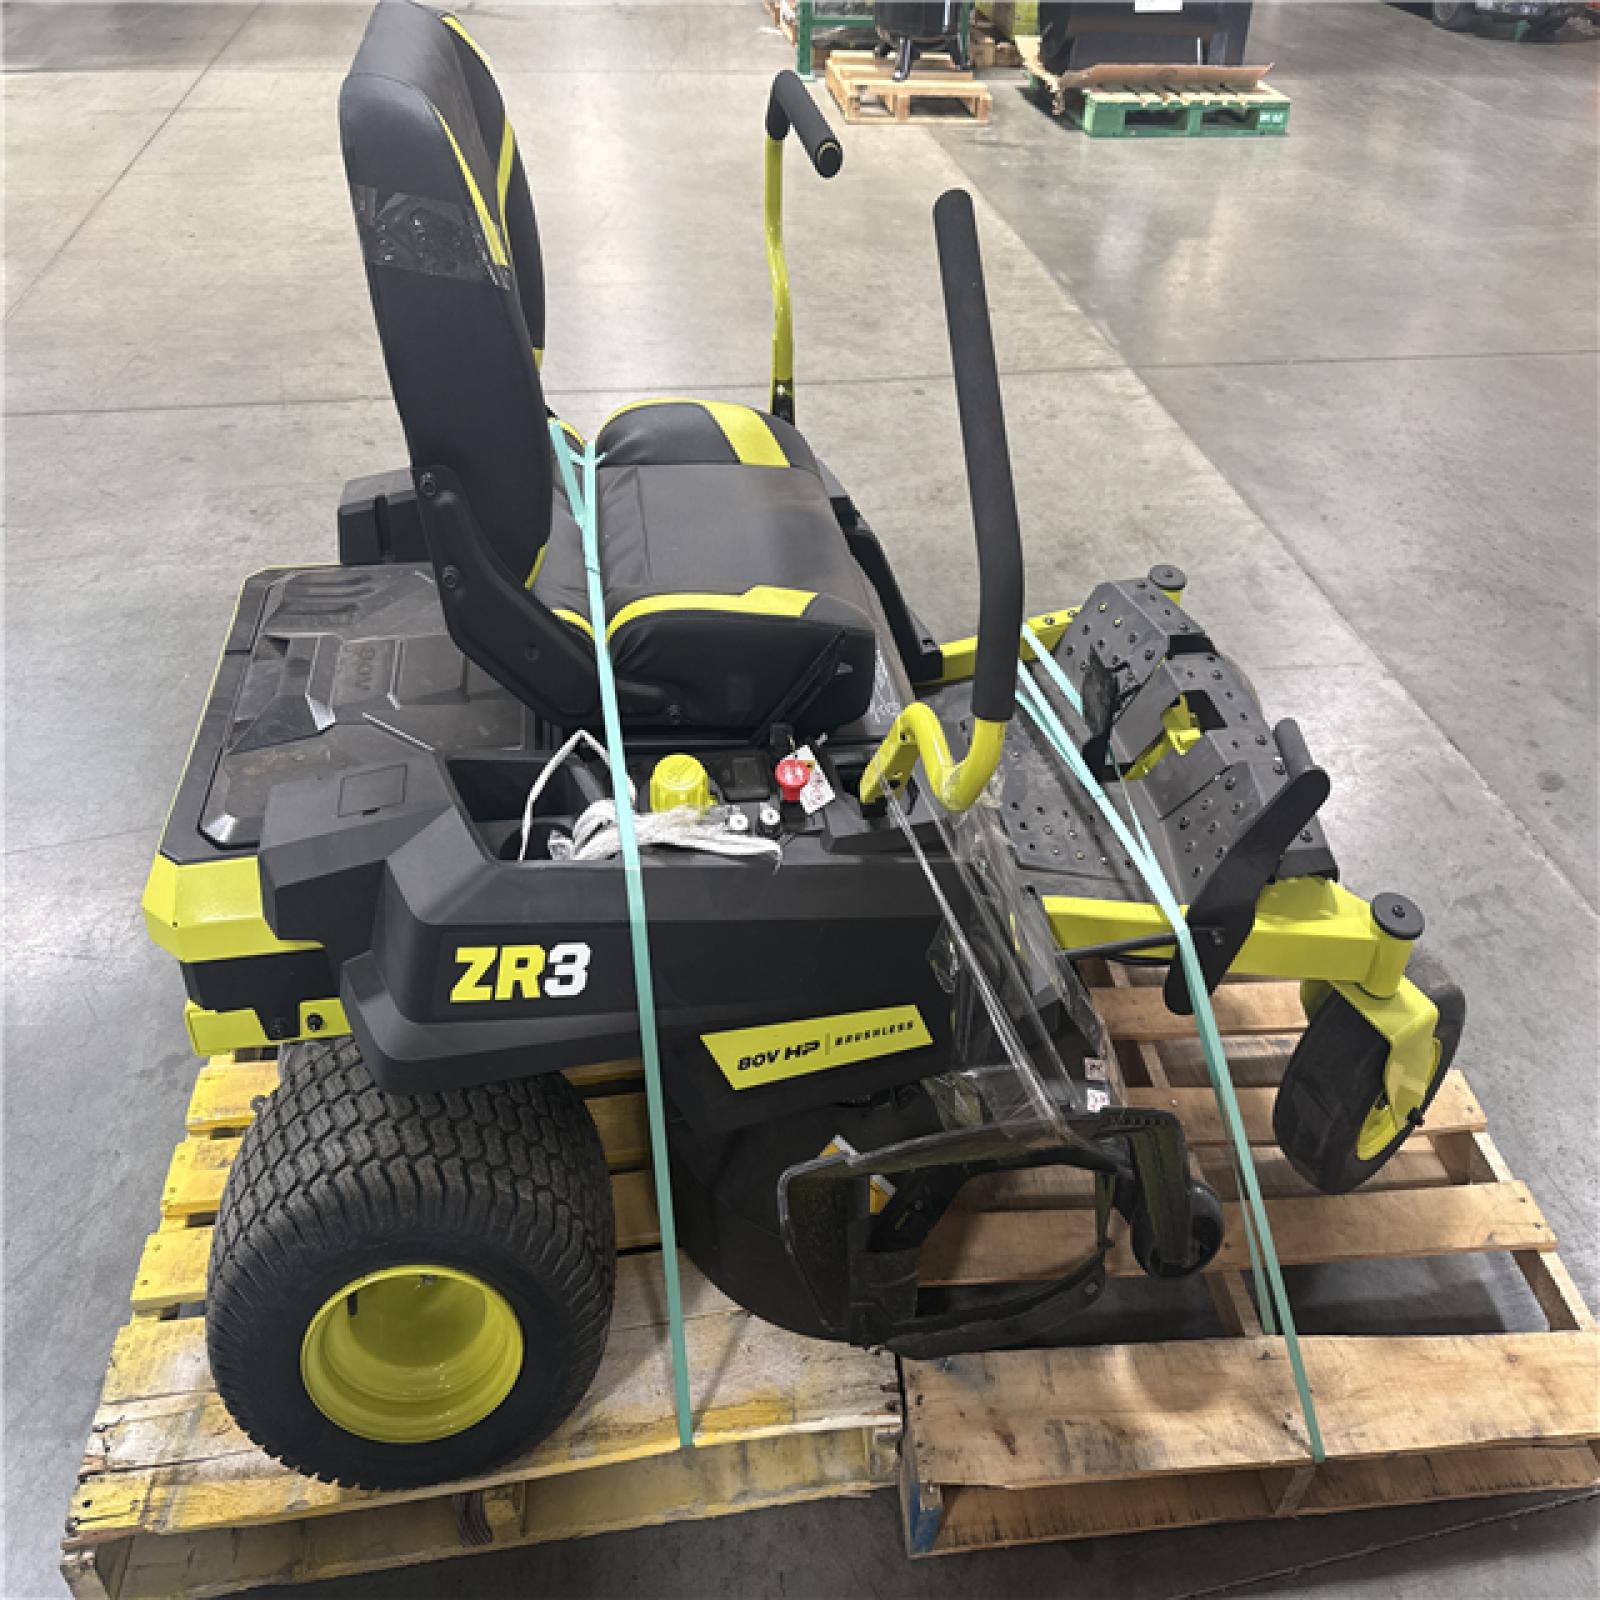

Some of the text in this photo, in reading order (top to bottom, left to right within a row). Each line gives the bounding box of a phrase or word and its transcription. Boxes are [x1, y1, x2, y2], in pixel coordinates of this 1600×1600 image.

[450, 942, 591, 1002] ZR3
[737, 1049, 780, 1071] 80V
[784, 1040, 820, 1061] HP
